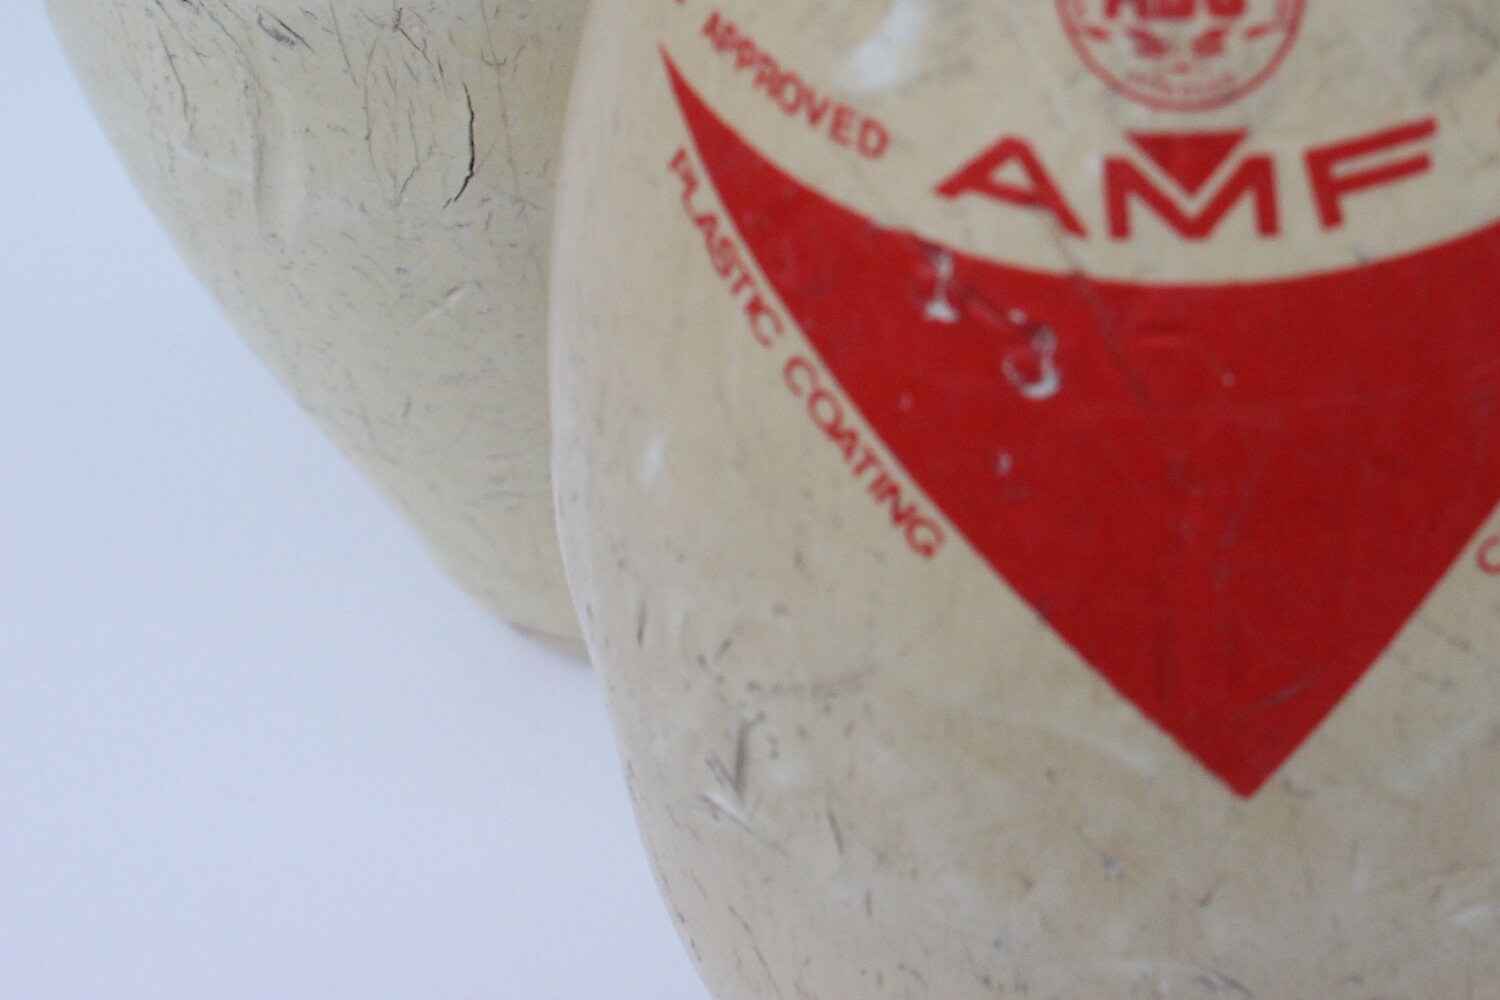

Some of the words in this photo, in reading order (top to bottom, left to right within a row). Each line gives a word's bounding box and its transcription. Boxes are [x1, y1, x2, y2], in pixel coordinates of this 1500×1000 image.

[703, 11, 891, 159] APPROVED
[934, 115, 1438, 241] AMF
[668, 147, 785, 350] PLASTIC
[783, 354, 946, 561] COATING
